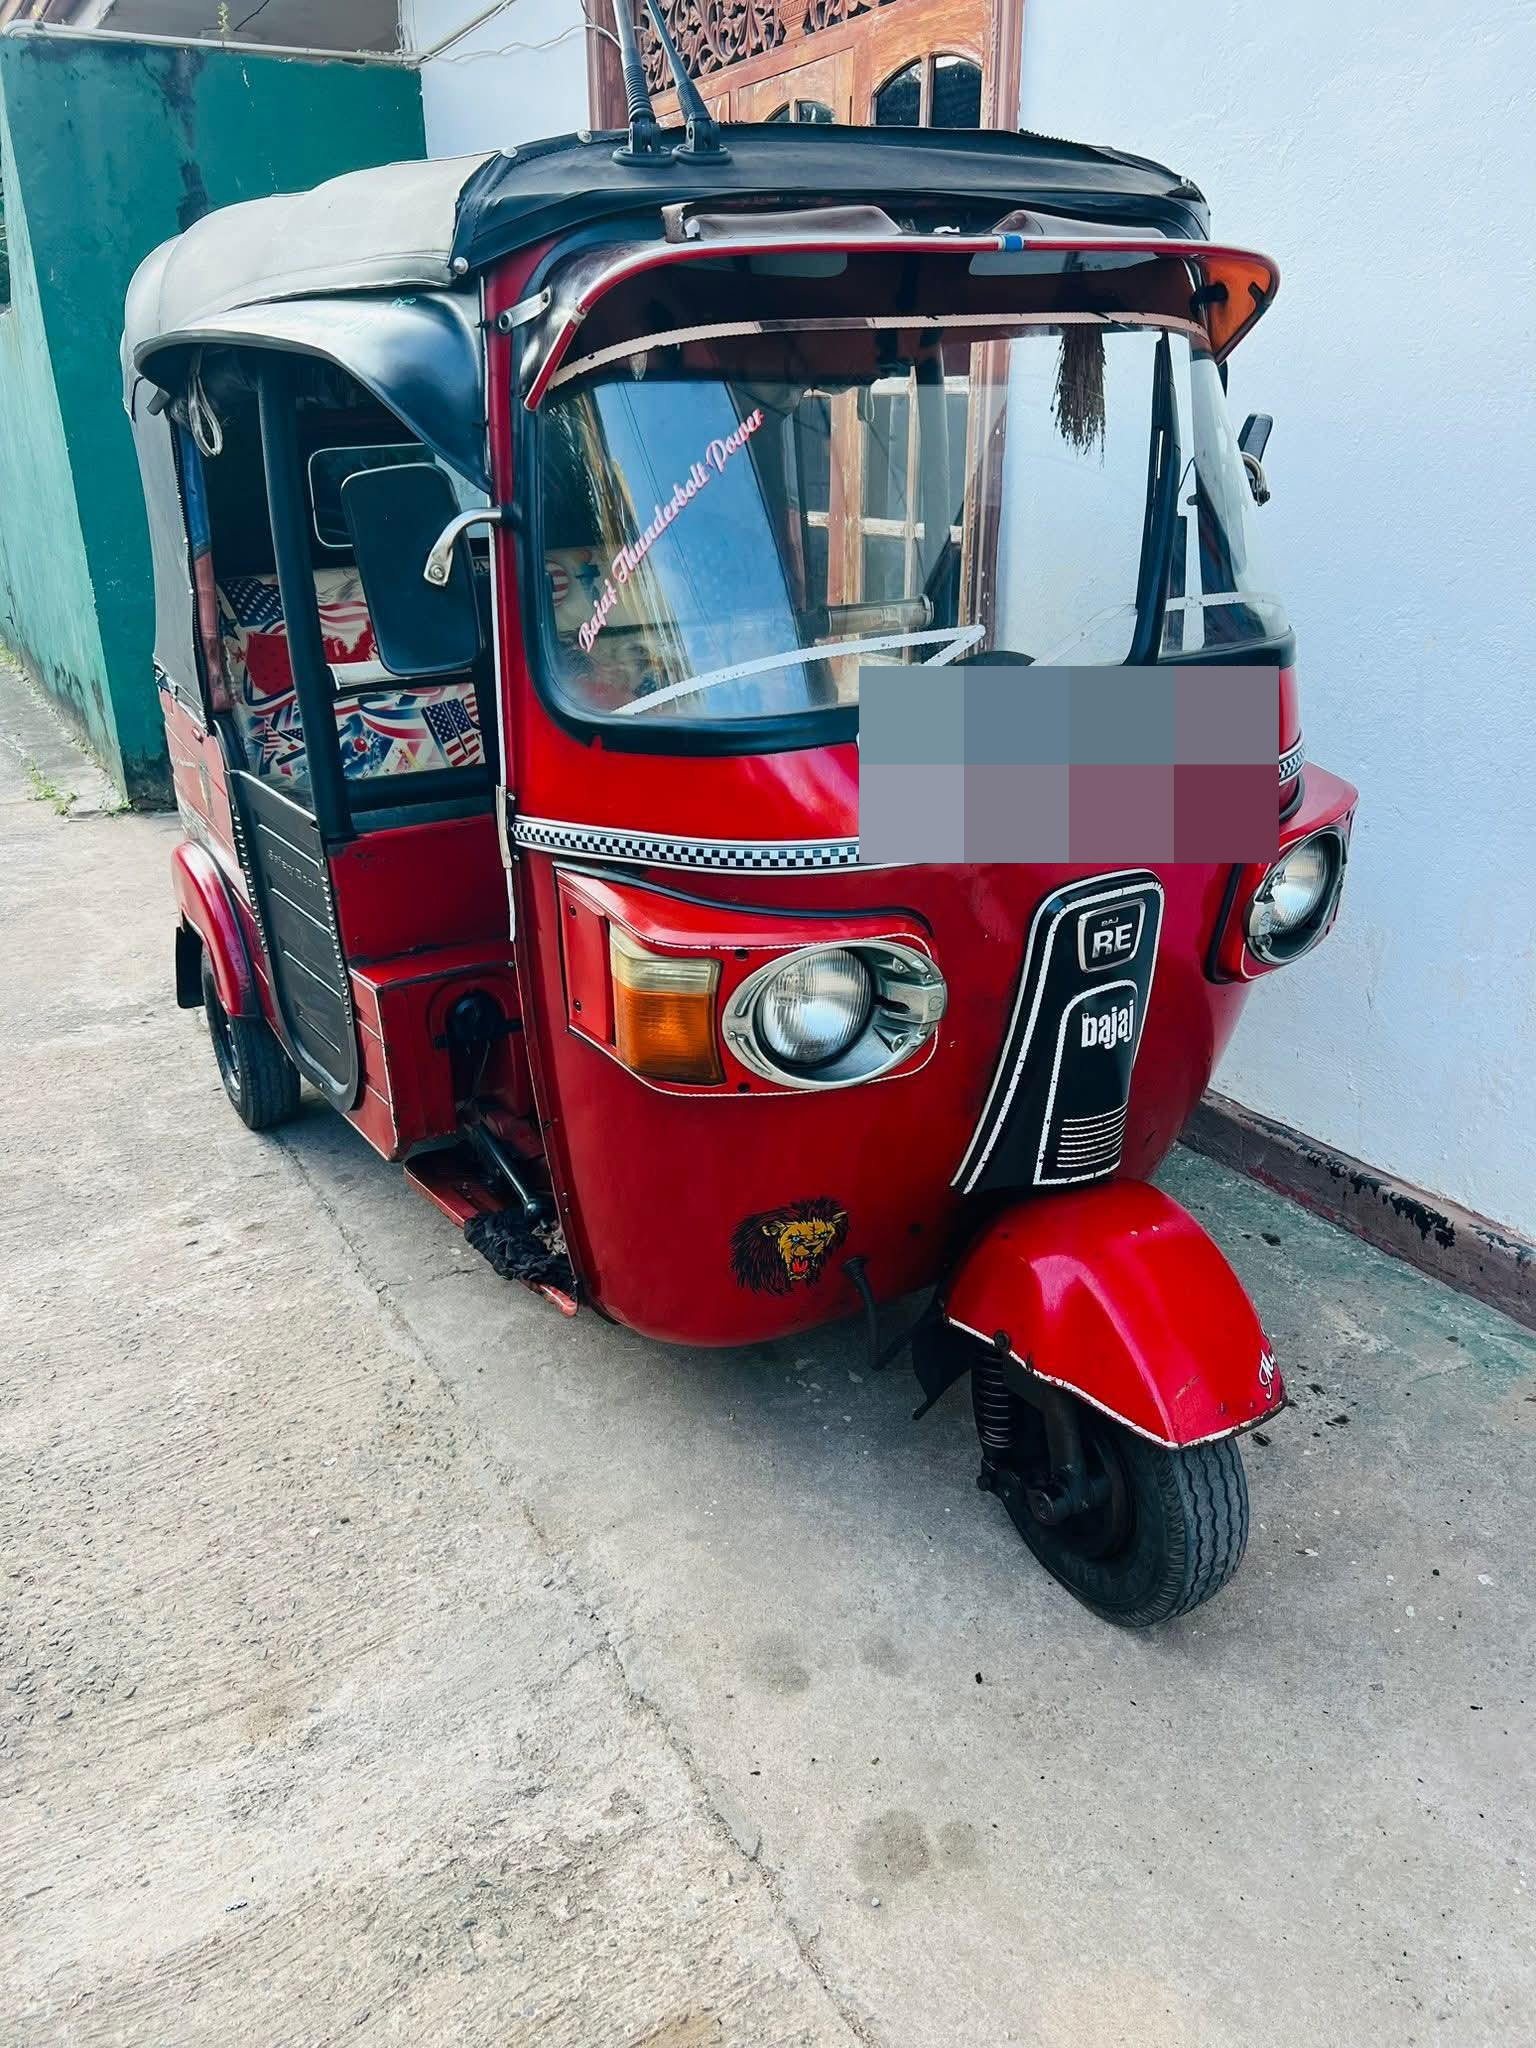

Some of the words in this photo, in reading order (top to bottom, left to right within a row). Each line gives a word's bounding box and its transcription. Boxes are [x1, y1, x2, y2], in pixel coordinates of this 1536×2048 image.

[578, 578, 617, 653] Bajaj
[611, 461, 711, 583] Thunderbolt
[705, 408, 764, 473] Power
[1091, 922, 1133, 959] RE
[1081, 999, 1134, 1050] bajaj
